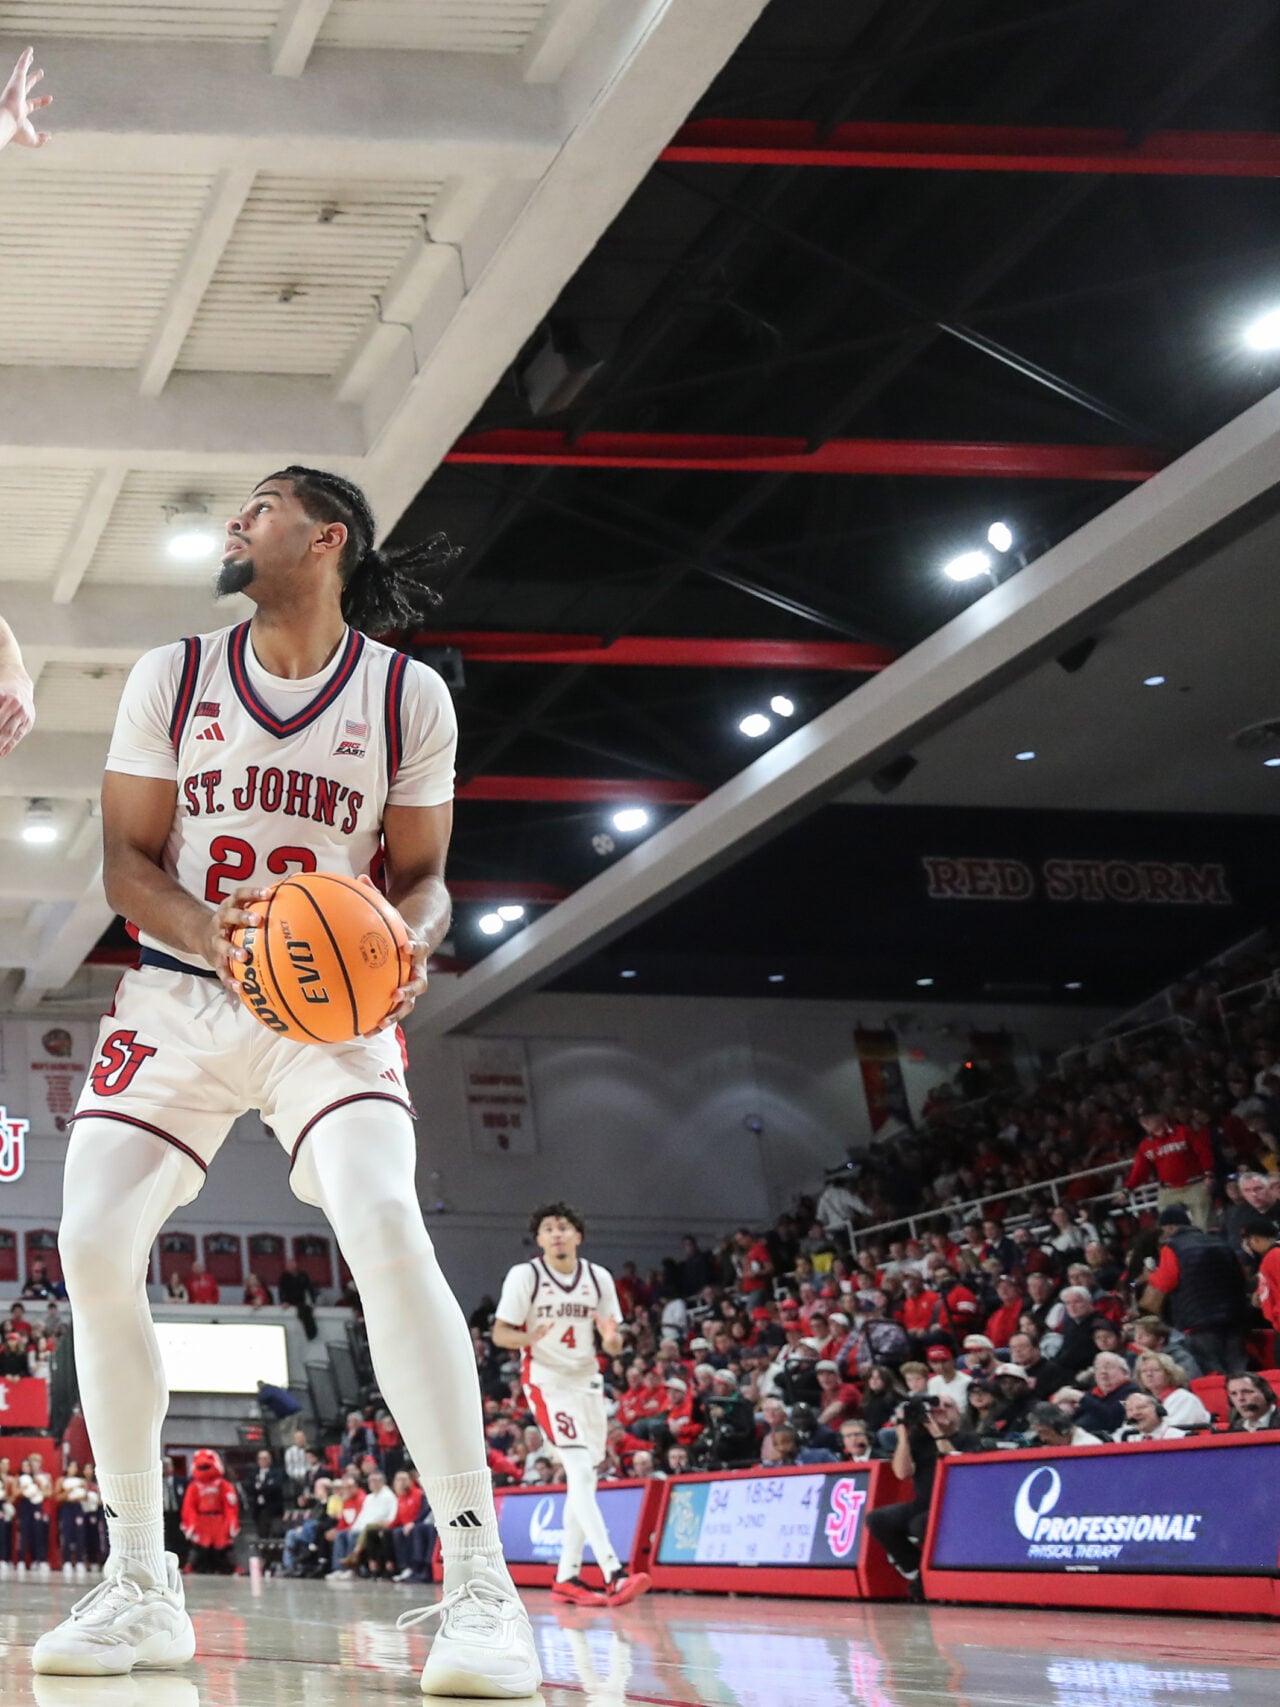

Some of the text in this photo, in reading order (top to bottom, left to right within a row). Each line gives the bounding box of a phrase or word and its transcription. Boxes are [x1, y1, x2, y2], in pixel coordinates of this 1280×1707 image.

[184, 766, 365, 835] ST. JOHN'S
[923, 857, 1232, 904] RED STORM
[286, 941, 330, 1004] EVO
[560, 1326, 576, 1349] 4
[709, 1489, 729, 1513] 34
[745, 1480, 784, 1504] 18:54
[1033, 1515, 1196, 1542] PROFESSIONAL
[1028, 1544, 1123, 1558] PHYSICAL THERAPY
